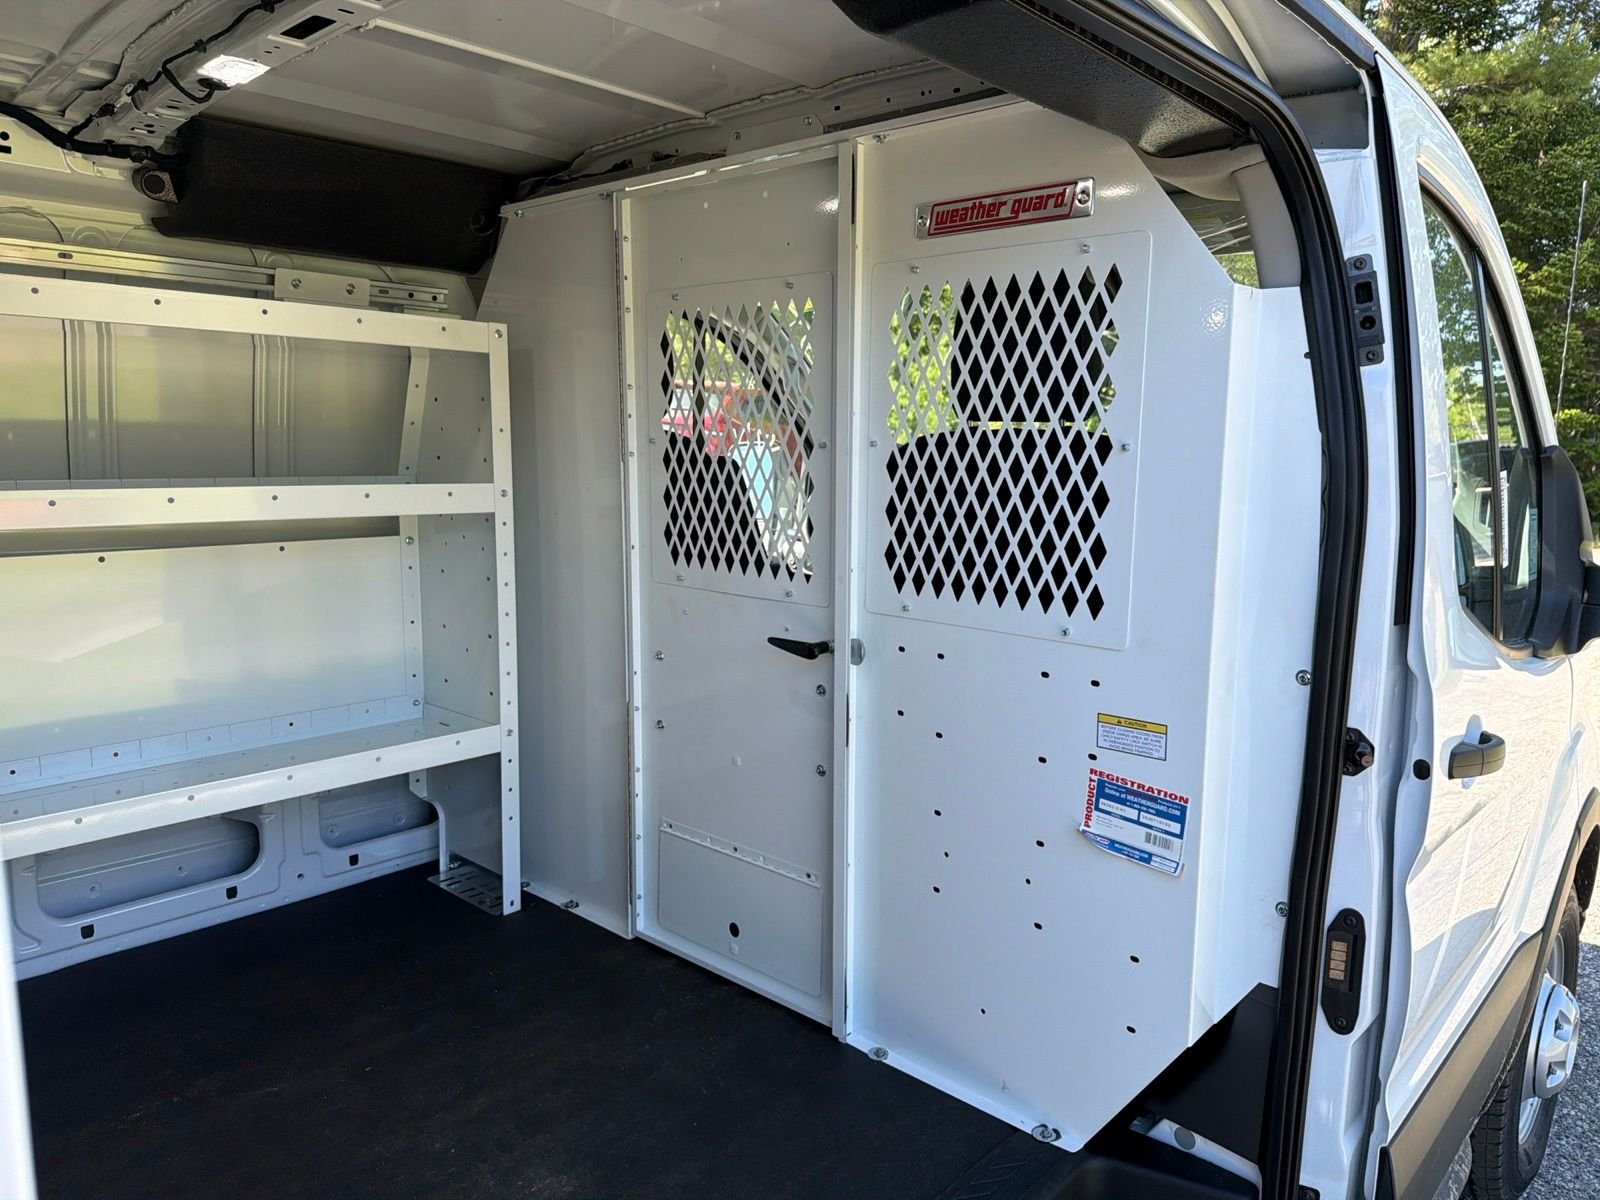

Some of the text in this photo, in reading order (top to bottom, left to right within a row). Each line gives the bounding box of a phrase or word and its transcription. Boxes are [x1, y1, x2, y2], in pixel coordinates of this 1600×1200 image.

[934, 187, 1068, 225] weather guard
[1124, 720, 1147, 729] CAUTION
[1084, 777, 1096, 828] PRODUCT
[1089, 768, 1189, 804] REGISTRATION
[1104, 787, 1120, 797] Online
[1126, 794, 1181, 816] WEATHERGUARD.COM
